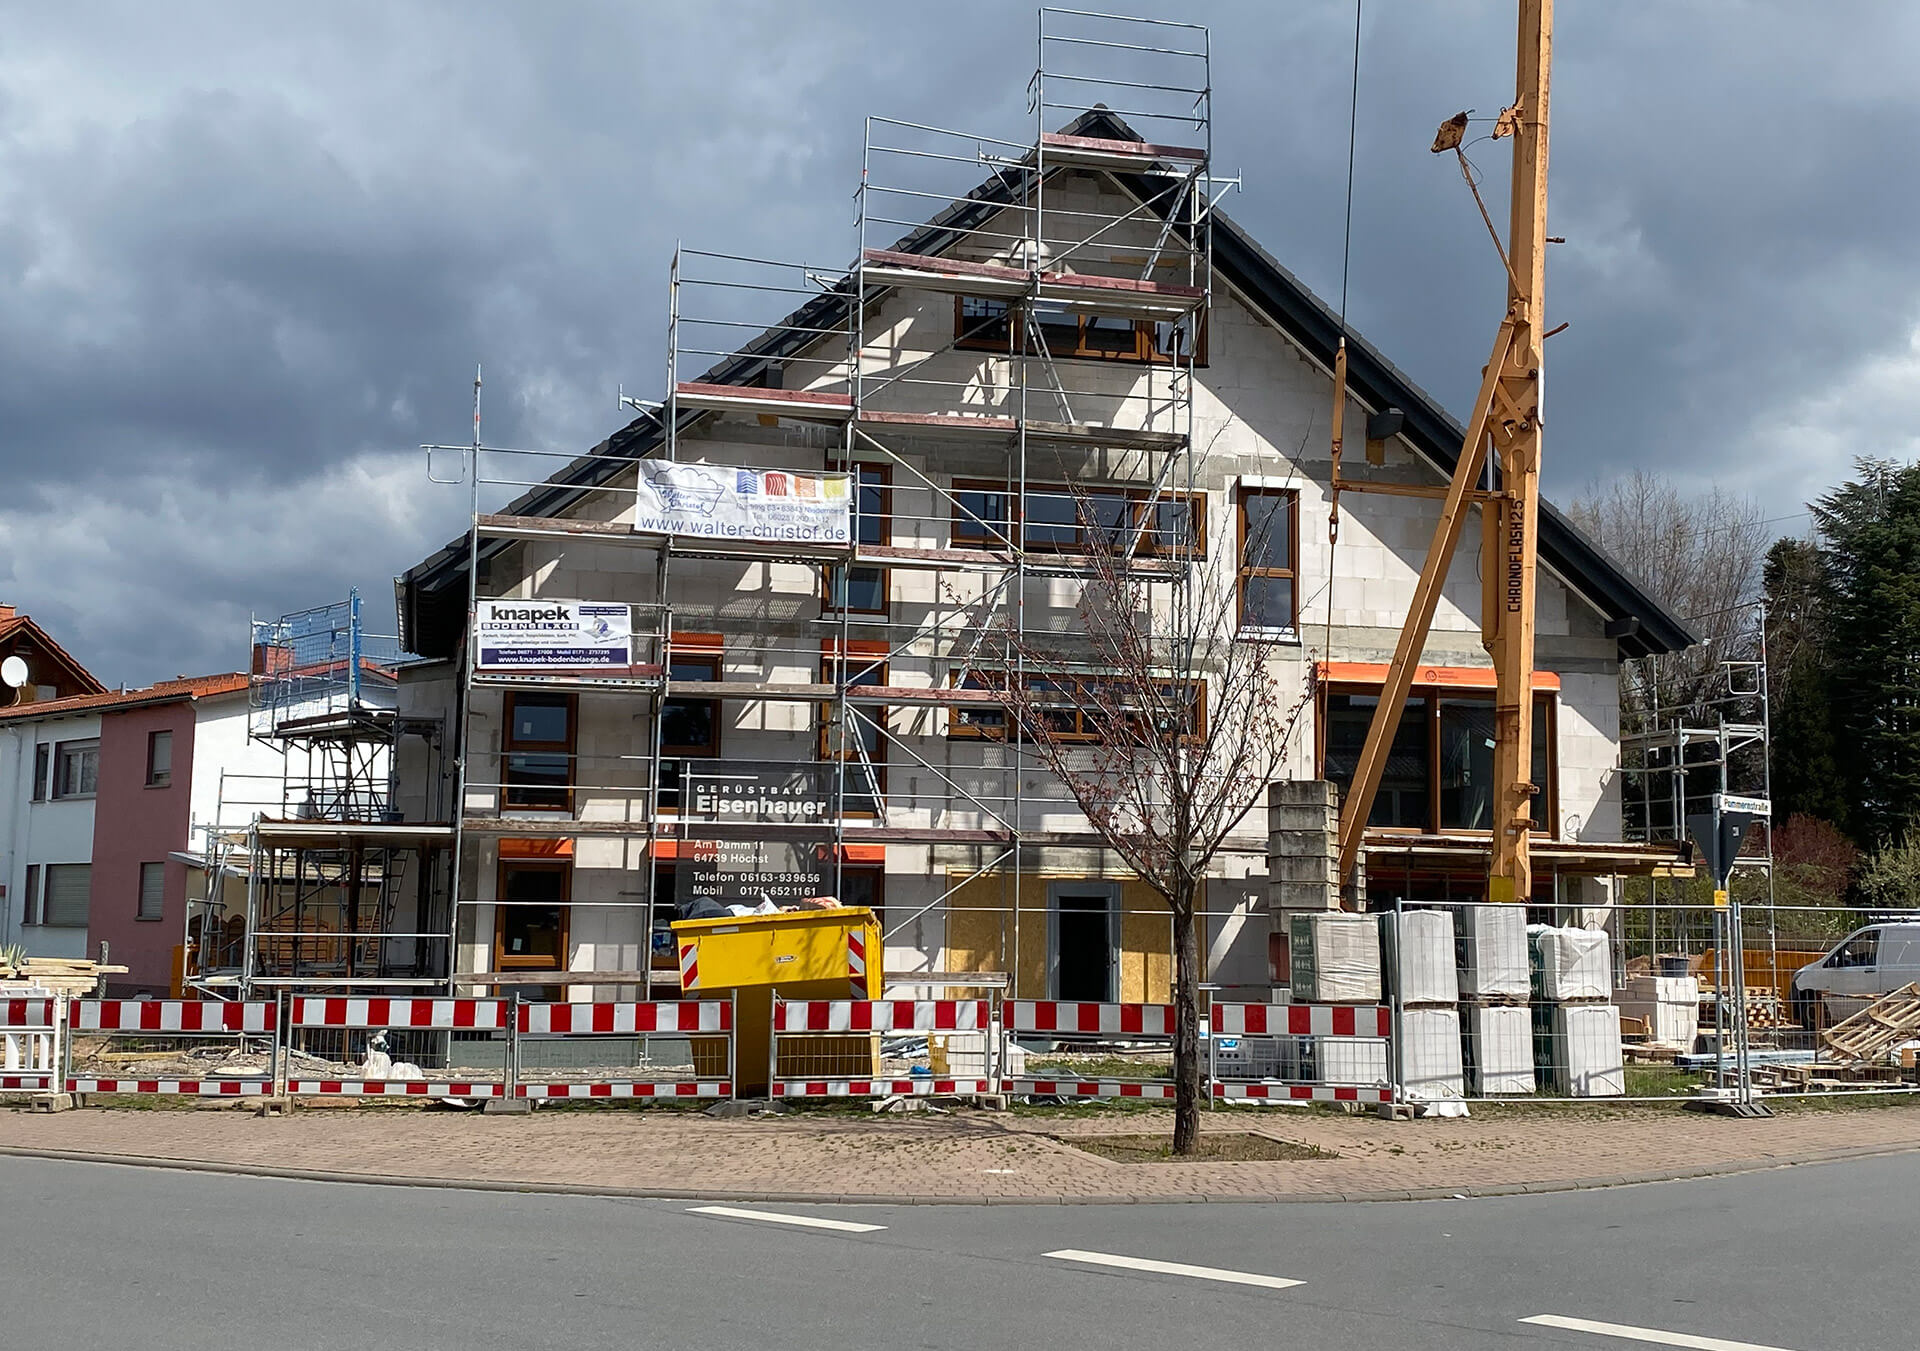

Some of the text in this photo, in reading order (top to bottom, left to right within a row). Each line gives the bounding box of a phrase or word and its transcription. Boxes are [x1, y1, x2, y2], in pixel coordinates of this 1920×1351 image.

[642, 517, 846, 540] www.walter-christof.de
[491, 606, 570, 623] knapek
[498, 655, 610, 665] www.knapek-bodenbelaege.de
[697, 784, 802, 796] GERÜSTBAU
[696, 795, 827, 815] Eisenhauer
[694, 840, 764, 850] Am Damm 11
[694, 853, 768, 863] 64739 Höchst
[693, 872, 734, 882] Telefon
[693, 885, 723, 895] Mobil
